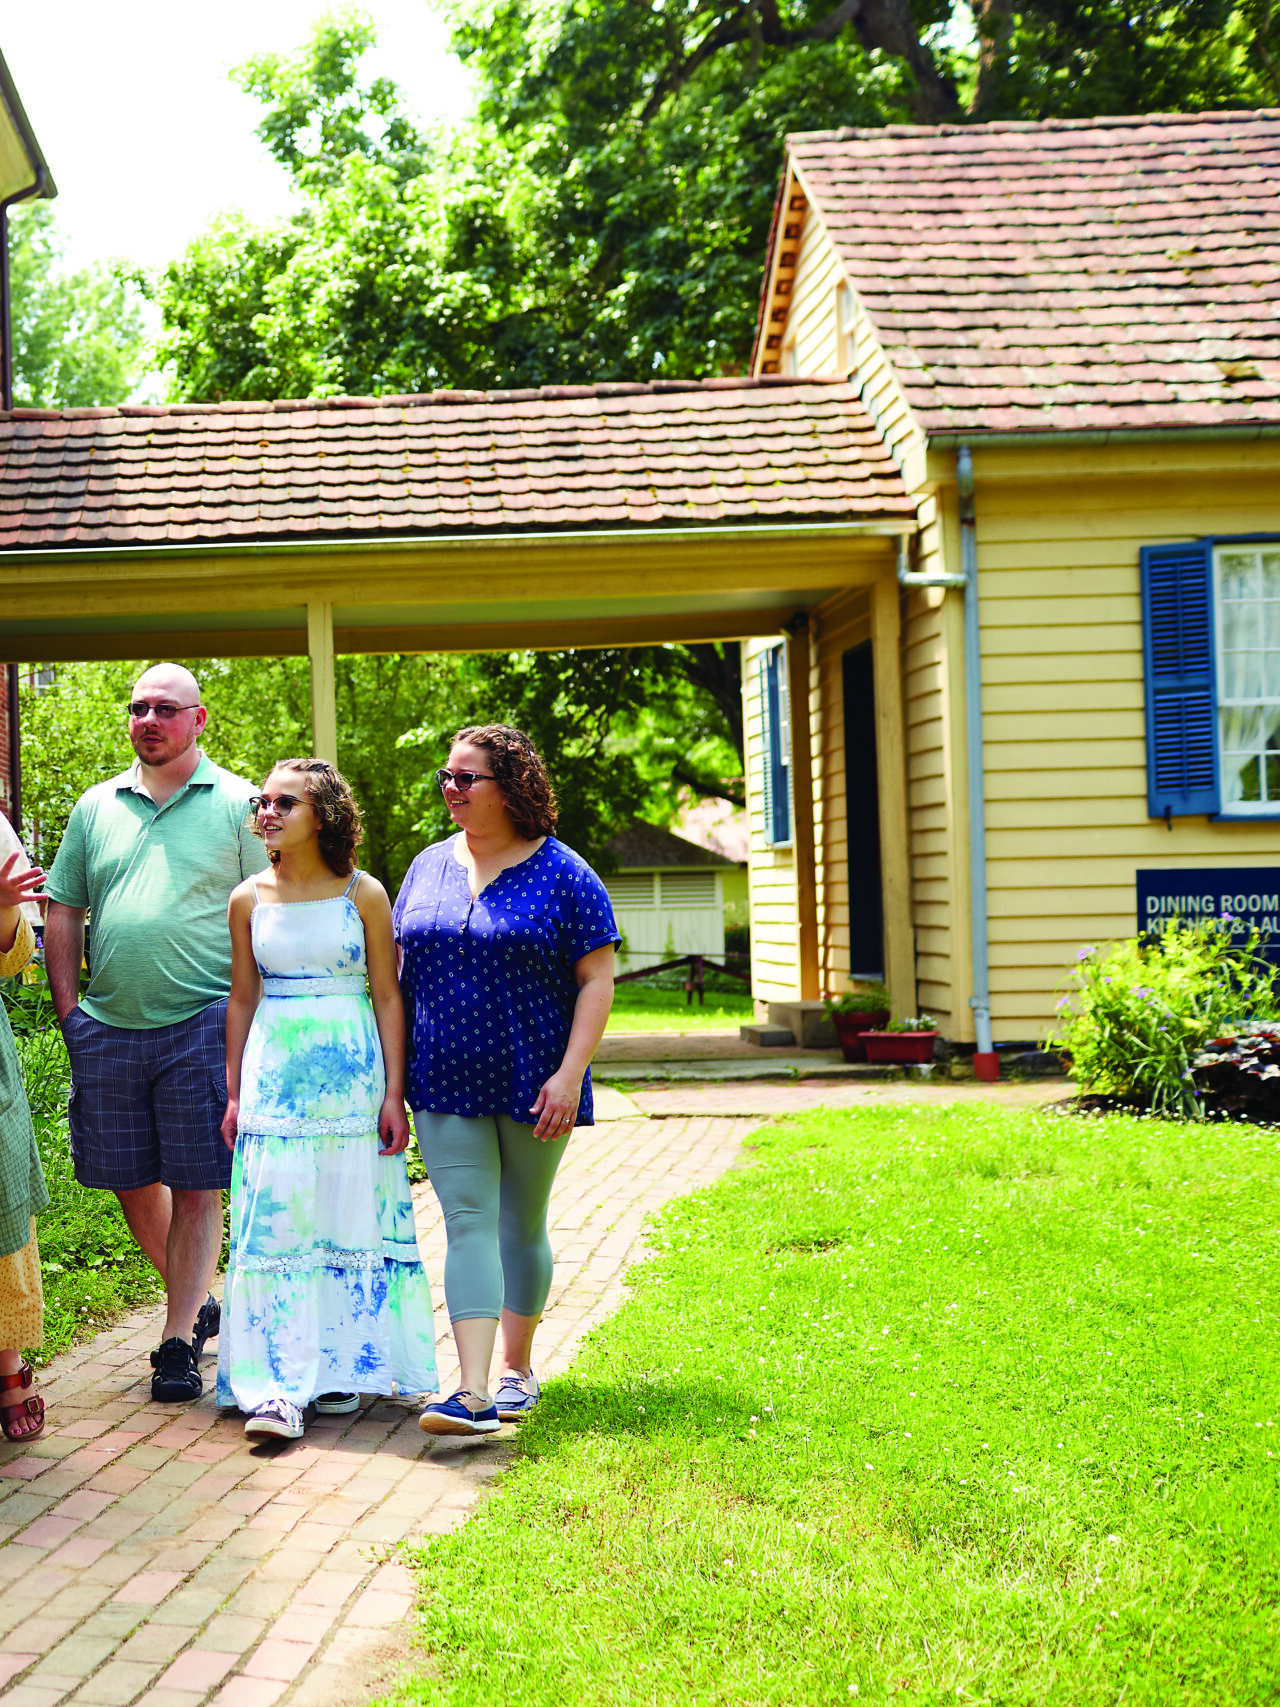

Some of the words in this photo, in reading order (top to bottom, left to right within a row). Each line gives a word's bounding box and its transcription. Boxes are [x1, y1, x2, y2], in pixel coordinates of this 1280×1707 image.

[1146, 895, 1215, 913] DINING
[1221, 894, 1279, 912] ROOM
[1231, 917, 1245, 934] &
